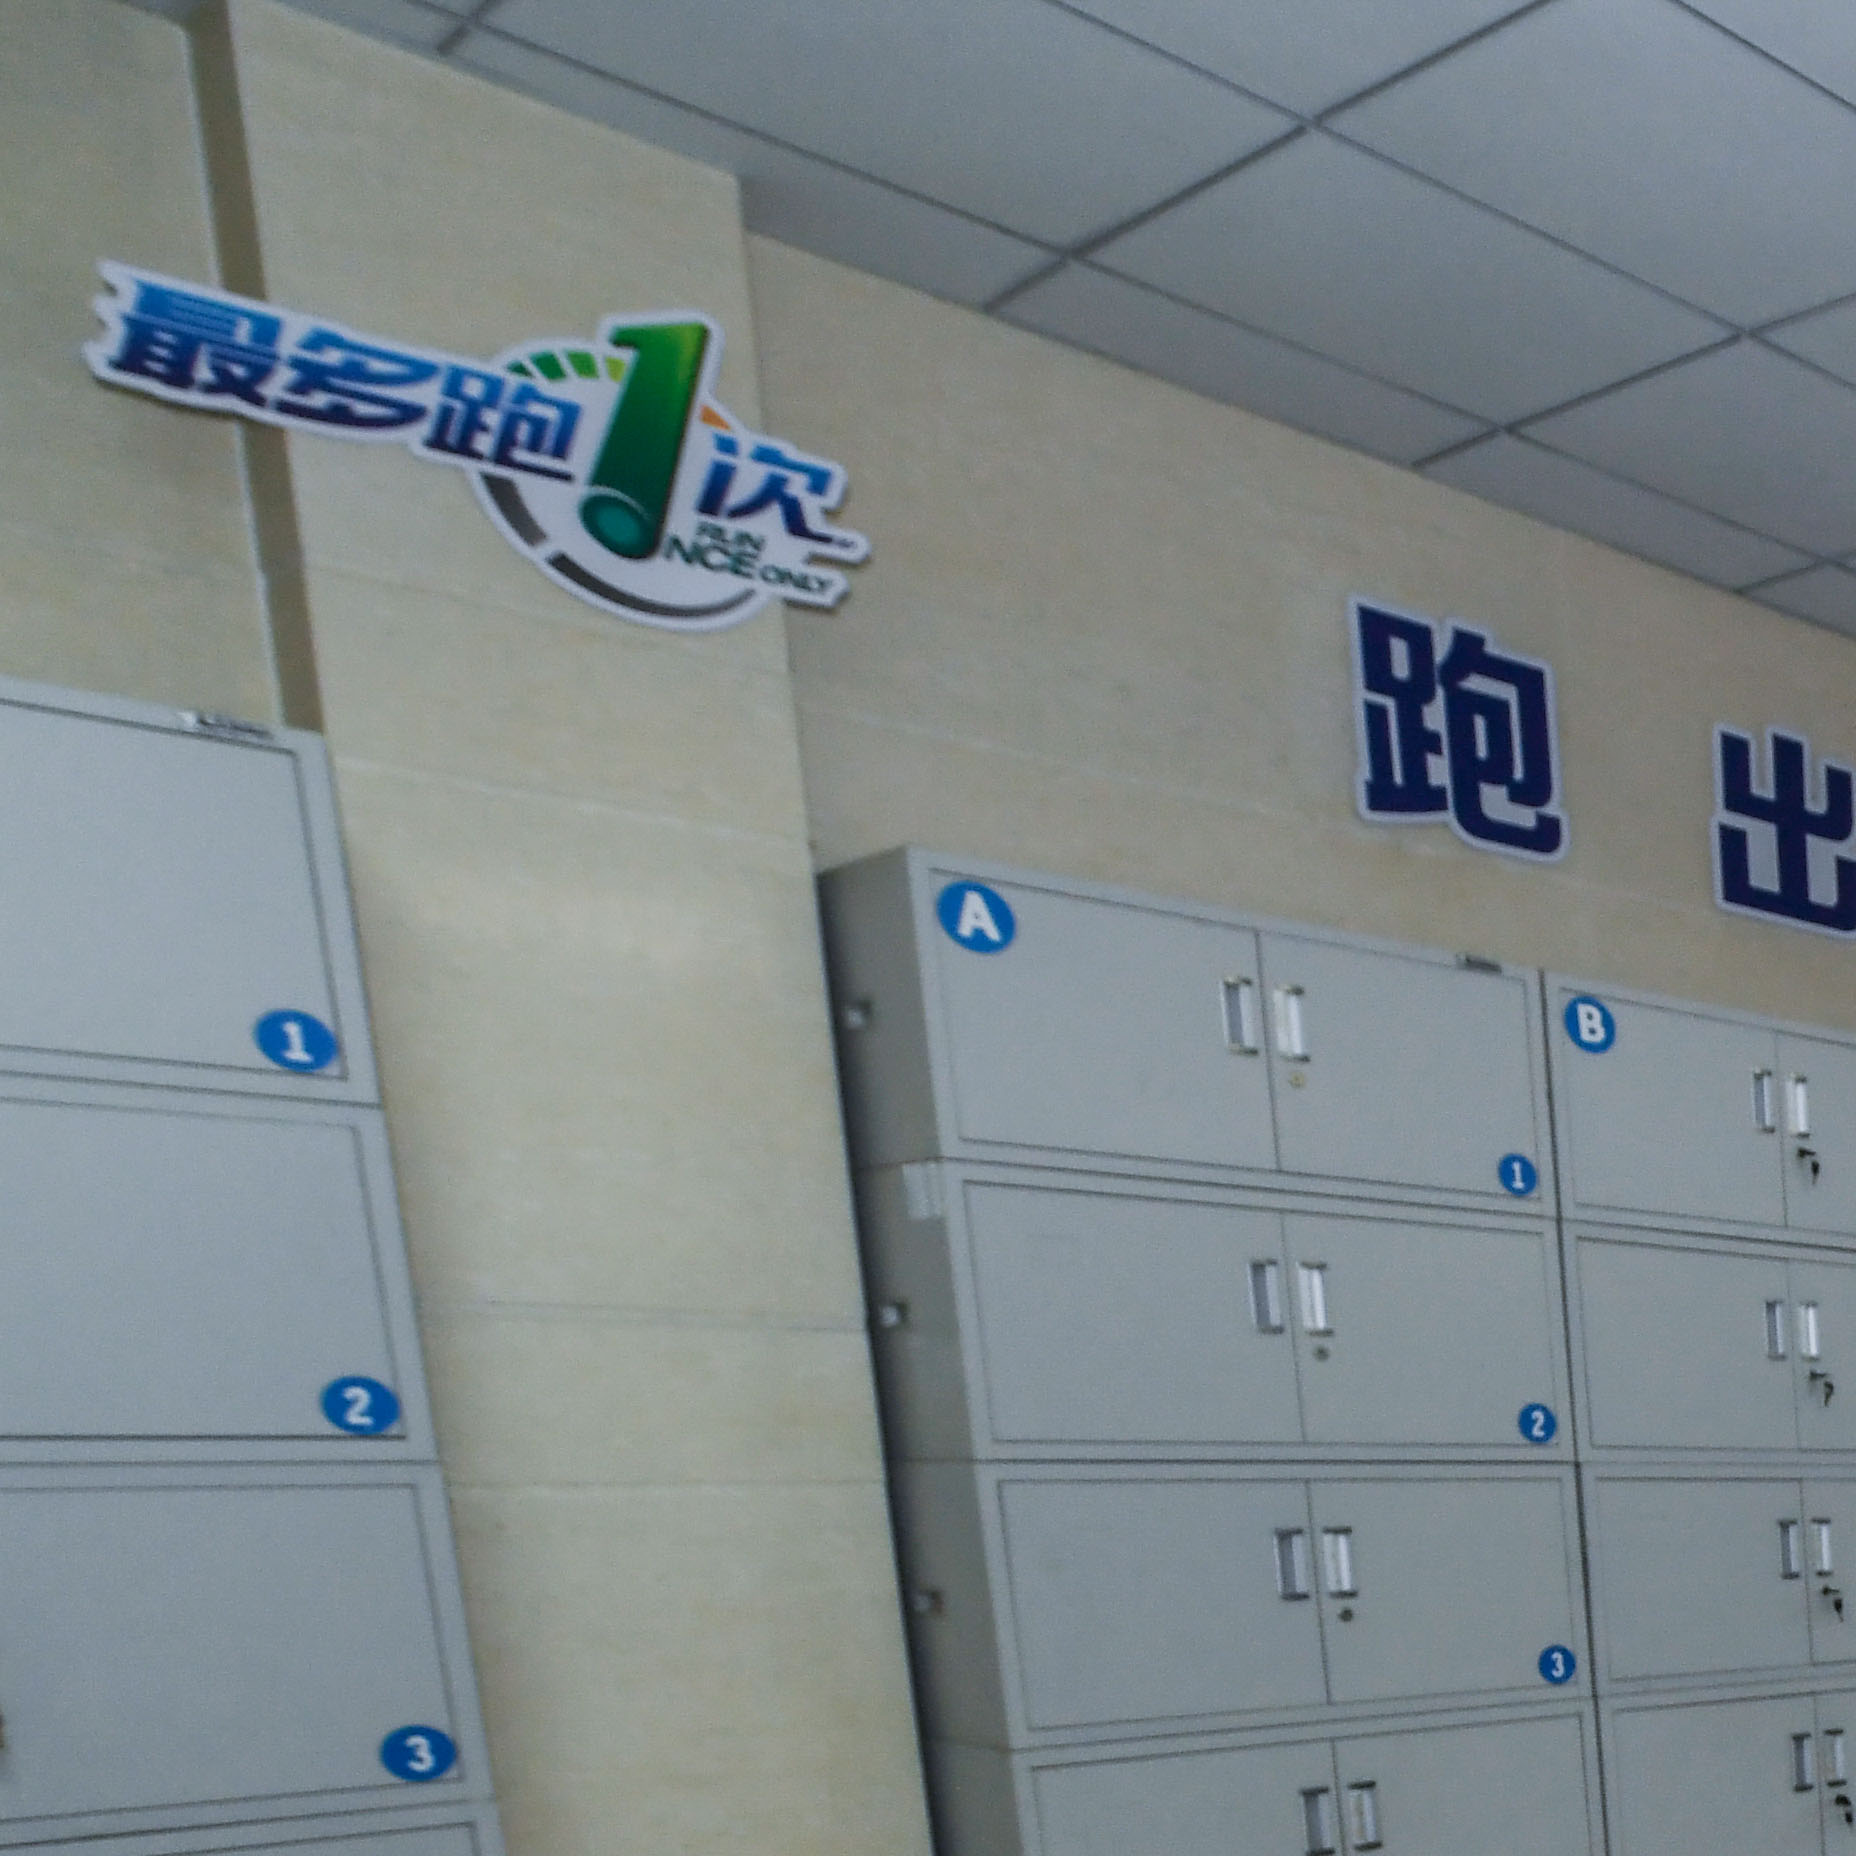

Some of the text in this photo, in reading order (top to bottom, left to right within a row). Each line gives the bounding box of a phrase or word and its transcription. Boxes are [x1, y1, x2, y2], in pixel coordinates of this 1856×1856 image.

[958, 891, 1000, 941] A
[283, 1022, 312, 1062] 1
[1577, 1004, 1605, 1043] B
[1512, 1162, 1525, 1189] 1
[343, 1386, 373, 1425] 2
[1531, 1410, 1545, 1437] 2
[1551, 1651, 1565, 1677] 3
[405, 1735, 433, 1772] 3
